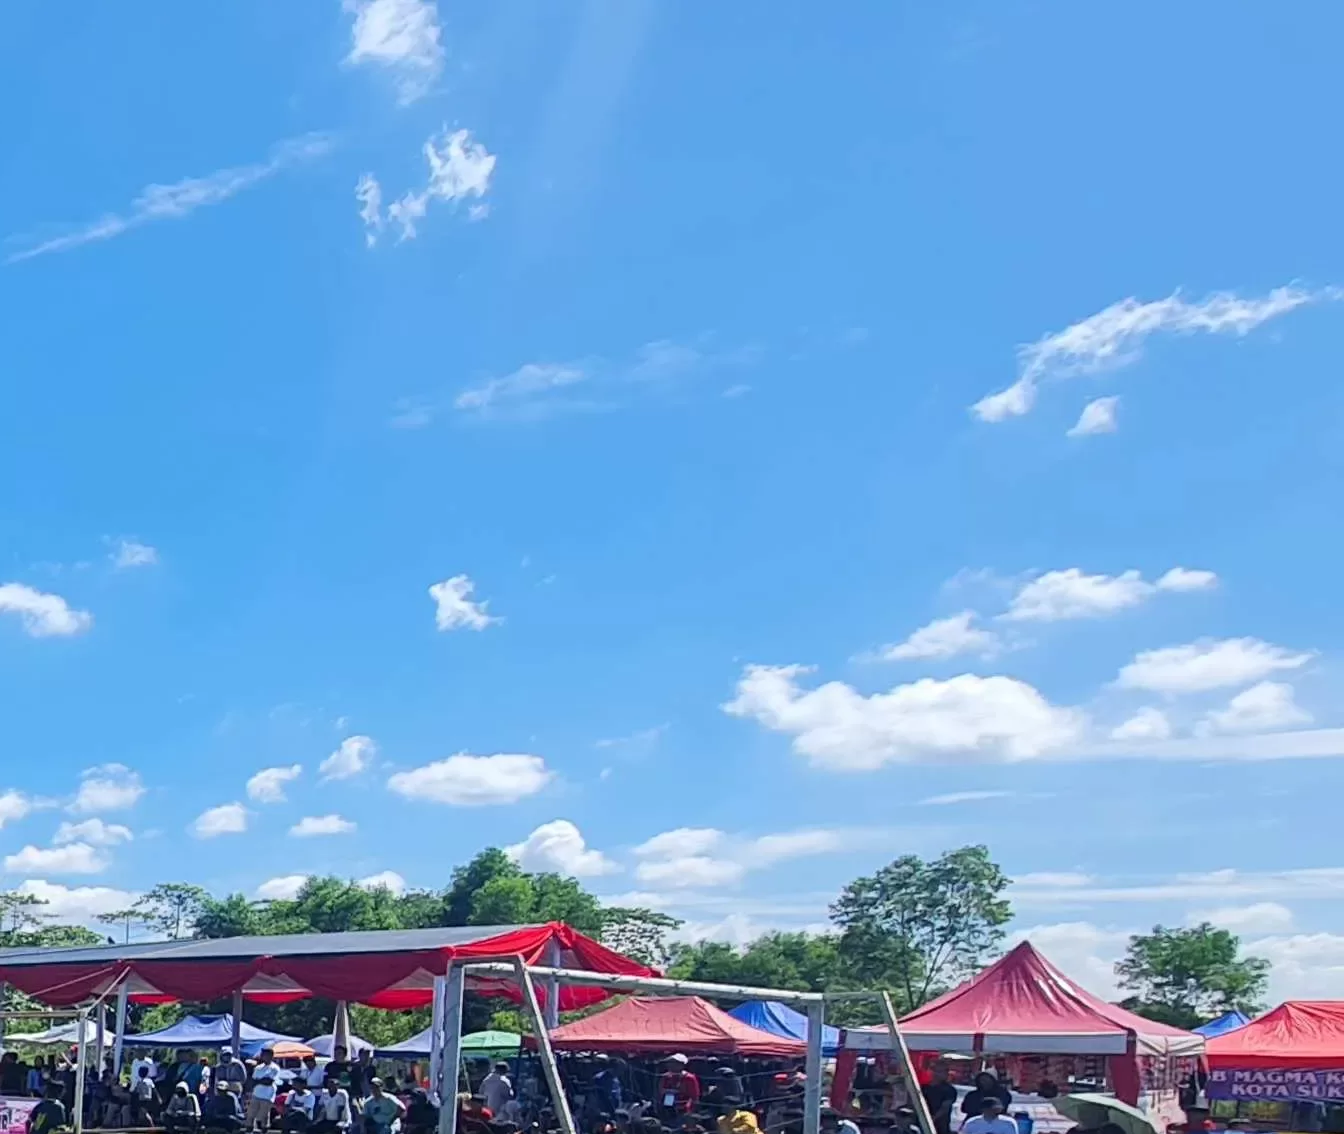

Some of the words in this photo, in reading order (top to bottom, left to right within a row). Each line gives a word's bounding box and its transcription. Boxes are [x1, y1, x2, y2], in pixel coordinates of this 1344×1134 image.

[1235, 1072, 1316, 1083] MAGMA
[1232, 1084, 1289, 1096] KOTA
[1298, 1085, 1344, 1098] SUK
